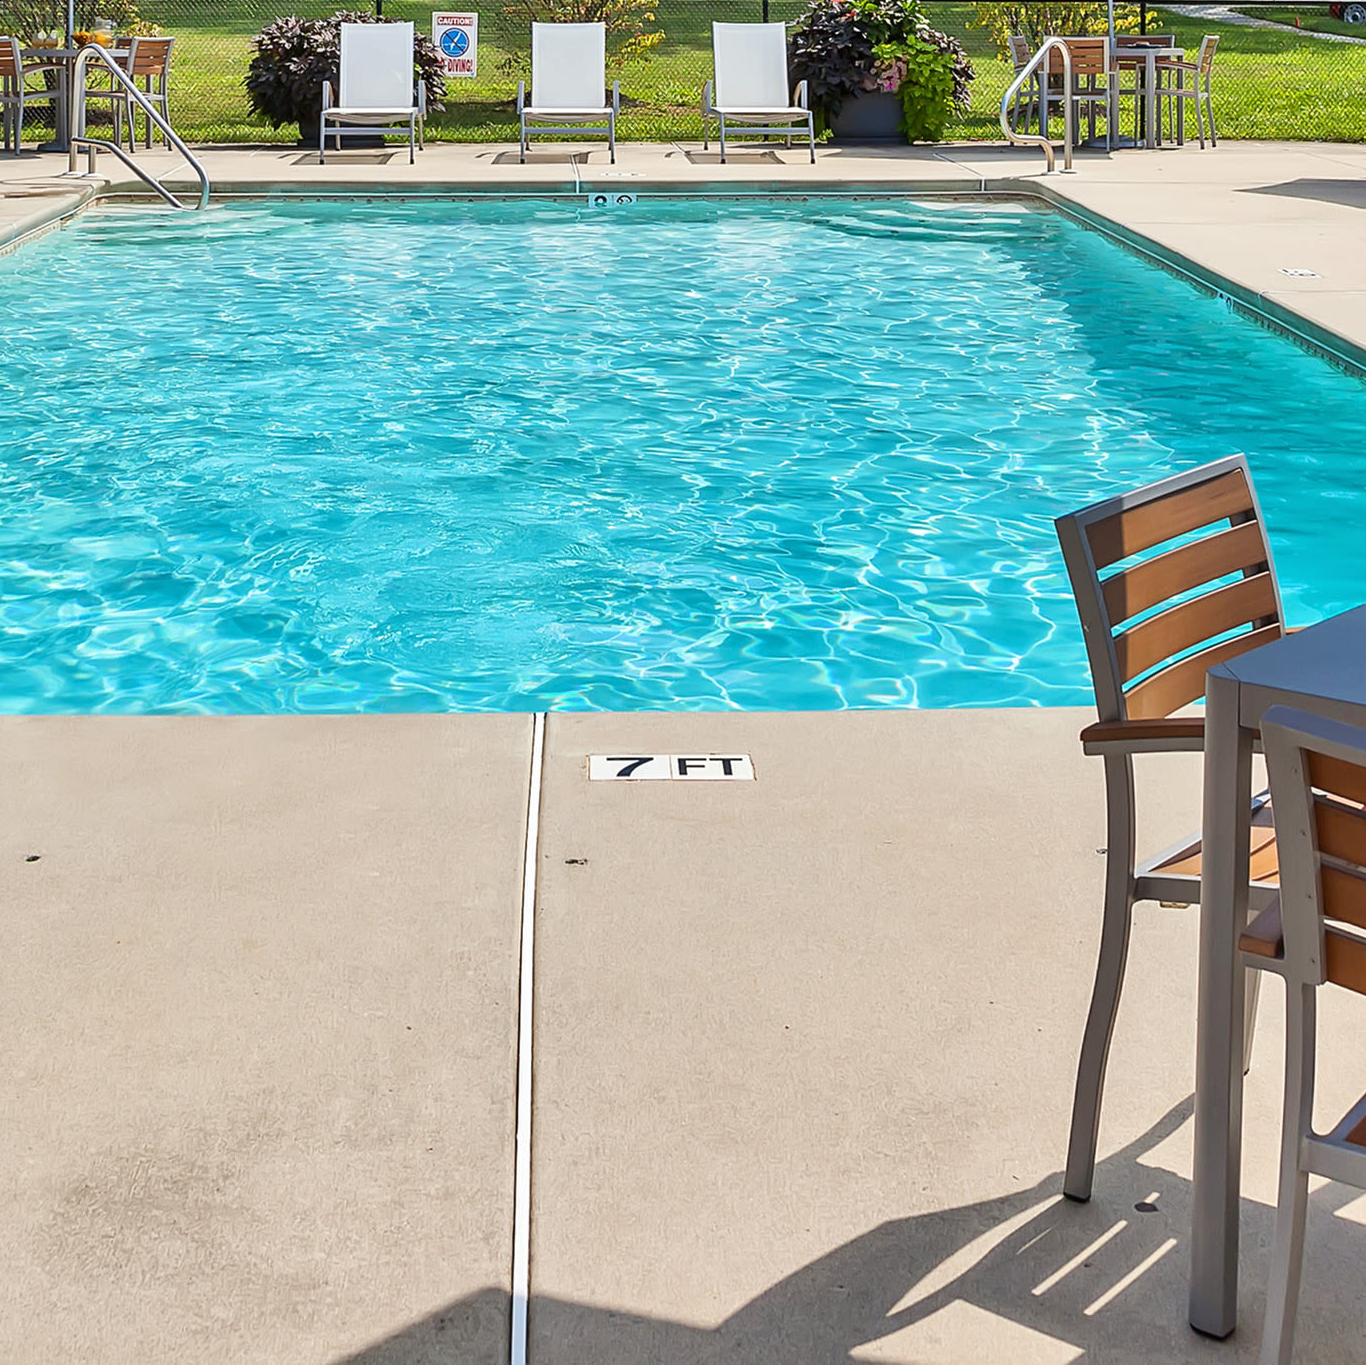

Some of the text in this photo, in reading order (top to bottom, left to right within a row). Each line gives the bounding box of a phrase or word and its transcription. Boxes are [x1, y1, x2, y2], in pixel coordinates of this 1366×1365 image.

[447, 58, 473, 73] DIVING!
[606, 757, 743, 777] 7 FT
